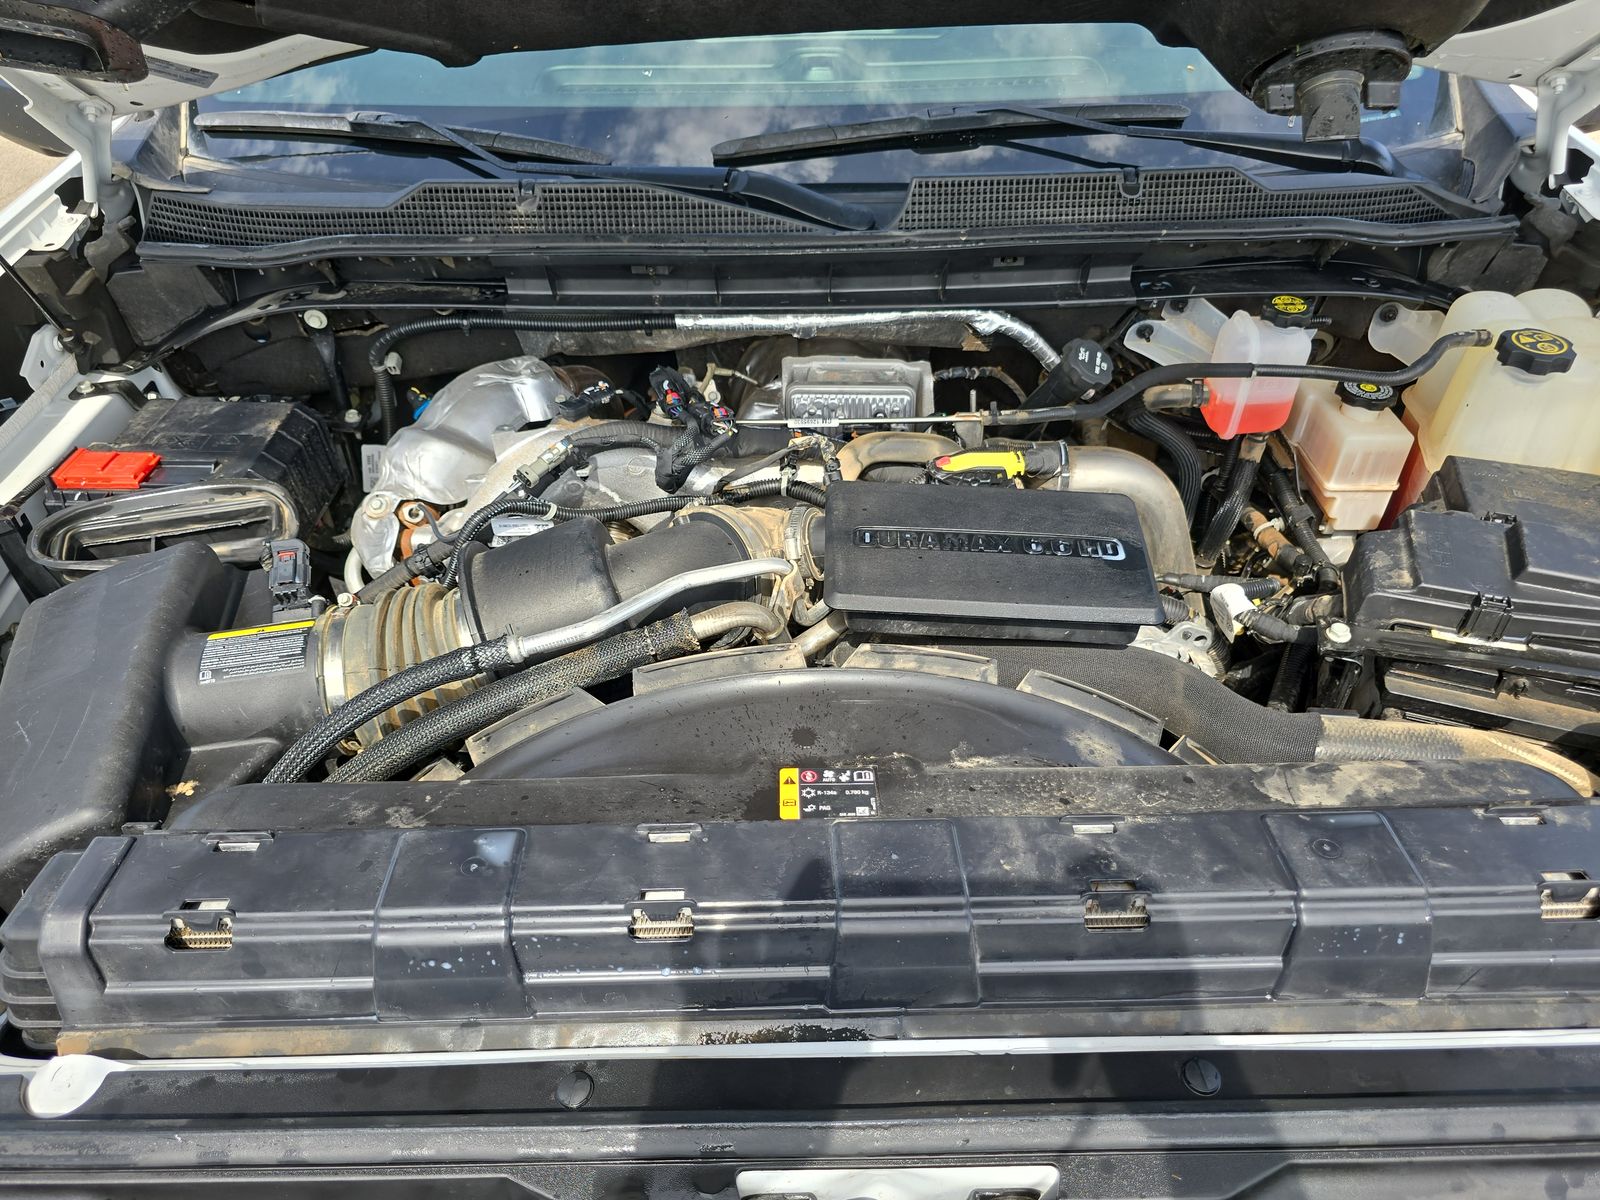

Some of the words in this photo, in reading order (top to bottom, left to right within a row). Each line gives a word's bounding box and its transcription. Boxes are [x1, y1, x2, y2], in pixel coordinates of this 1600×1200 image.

[857, 531, 1013, 553] DURAMAX
[1022, 537, 1073, 556] 6.6
[1077, 538, 1127, 561] HD
